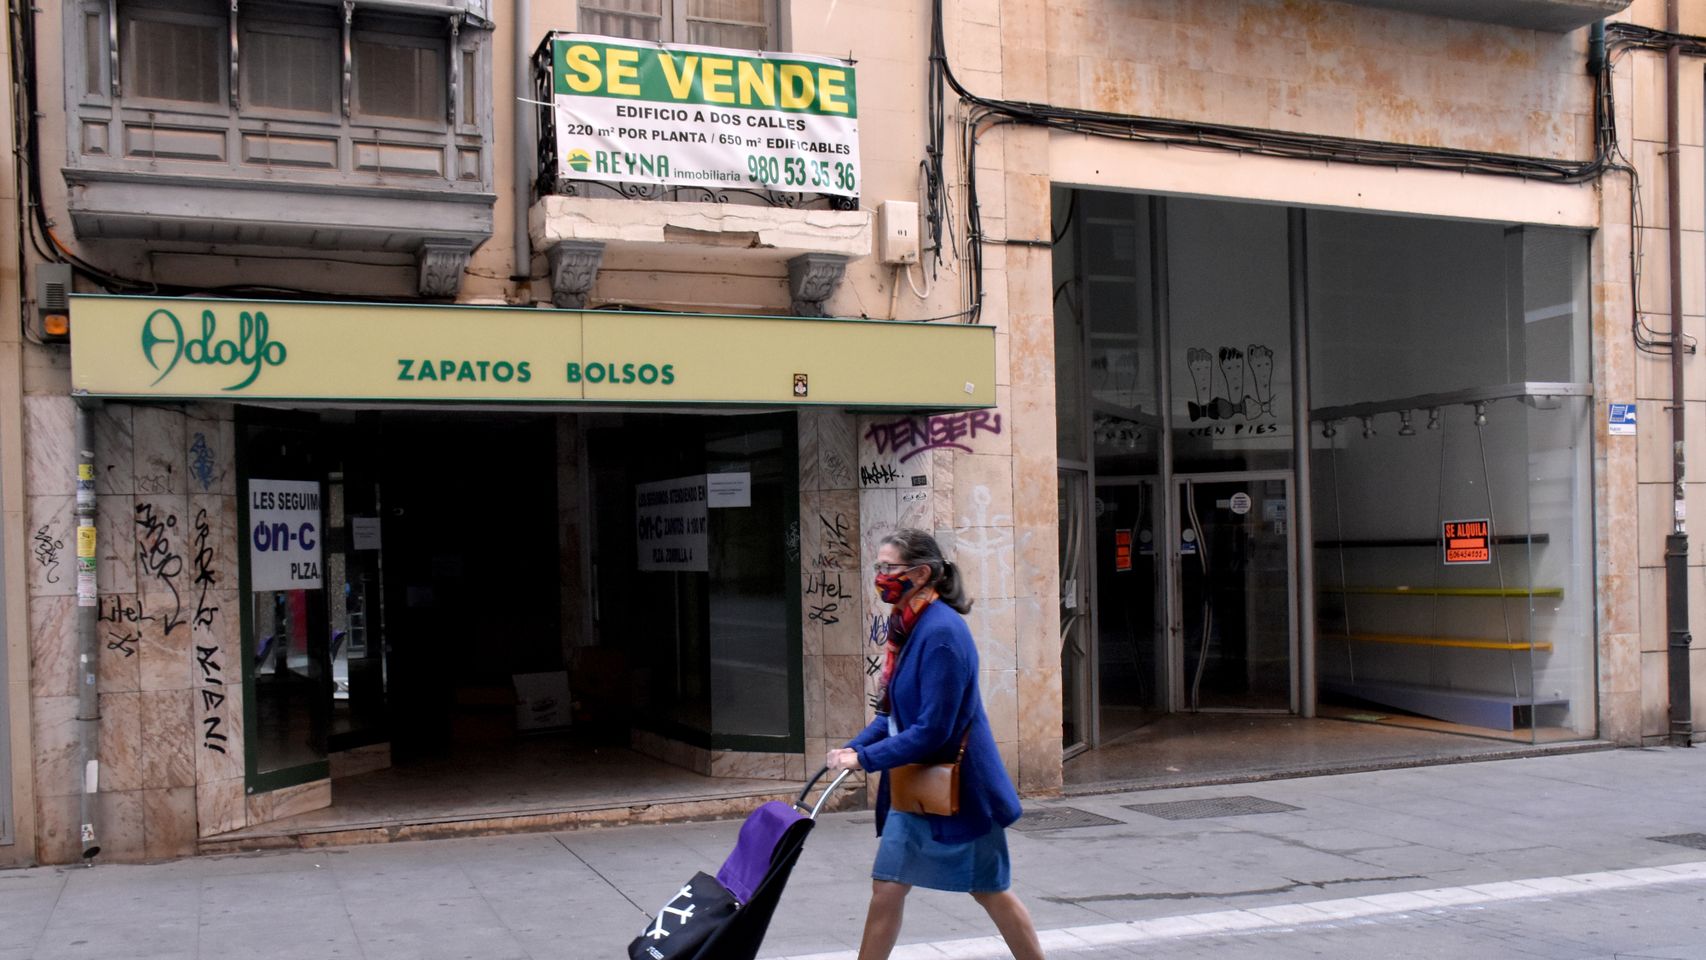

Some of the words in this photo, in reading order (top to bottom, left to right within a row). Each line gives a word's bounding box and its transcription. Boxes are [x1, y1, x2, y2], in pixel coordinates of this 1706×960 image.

[565, 45, 641, 96] SE
[657, 53, 849, 113] VENDE
[616, 105, 688, 122] EDIFICIO
[694, 111, 705, 122] A
[710, 112, 741, 126] DOS
[747, 116, 806, 131] CALLES
[567, 124, 593, 136] 220
[618, 128, 648, 140] POR
[652, 131, 707, 143] PLANTA
[719, 134, 742, 145] 650
[766, 138, 850, 155] EDIFICABLES
[595, 150, 670, 178] REYNA
[674, 167, 741, 182] inmobiliaria
[748, 155, 779, 184] 980
[784, 157, 807, 186] 53
[811, 160, 831, 187] 35
[835, 161, 856, 191] 36
[141, 309, 287, 391] Adolfo
[397, 359, 532, 383] ZAPATOS
[566, 362, 675, 385] BOLSOS
[1234, 423, 1278, 435] PIES
[253, 491, 275, 510] LES
[1446, 524, 1455, 537] SE
[1457, 522, 1487, 538] ALQUILA
